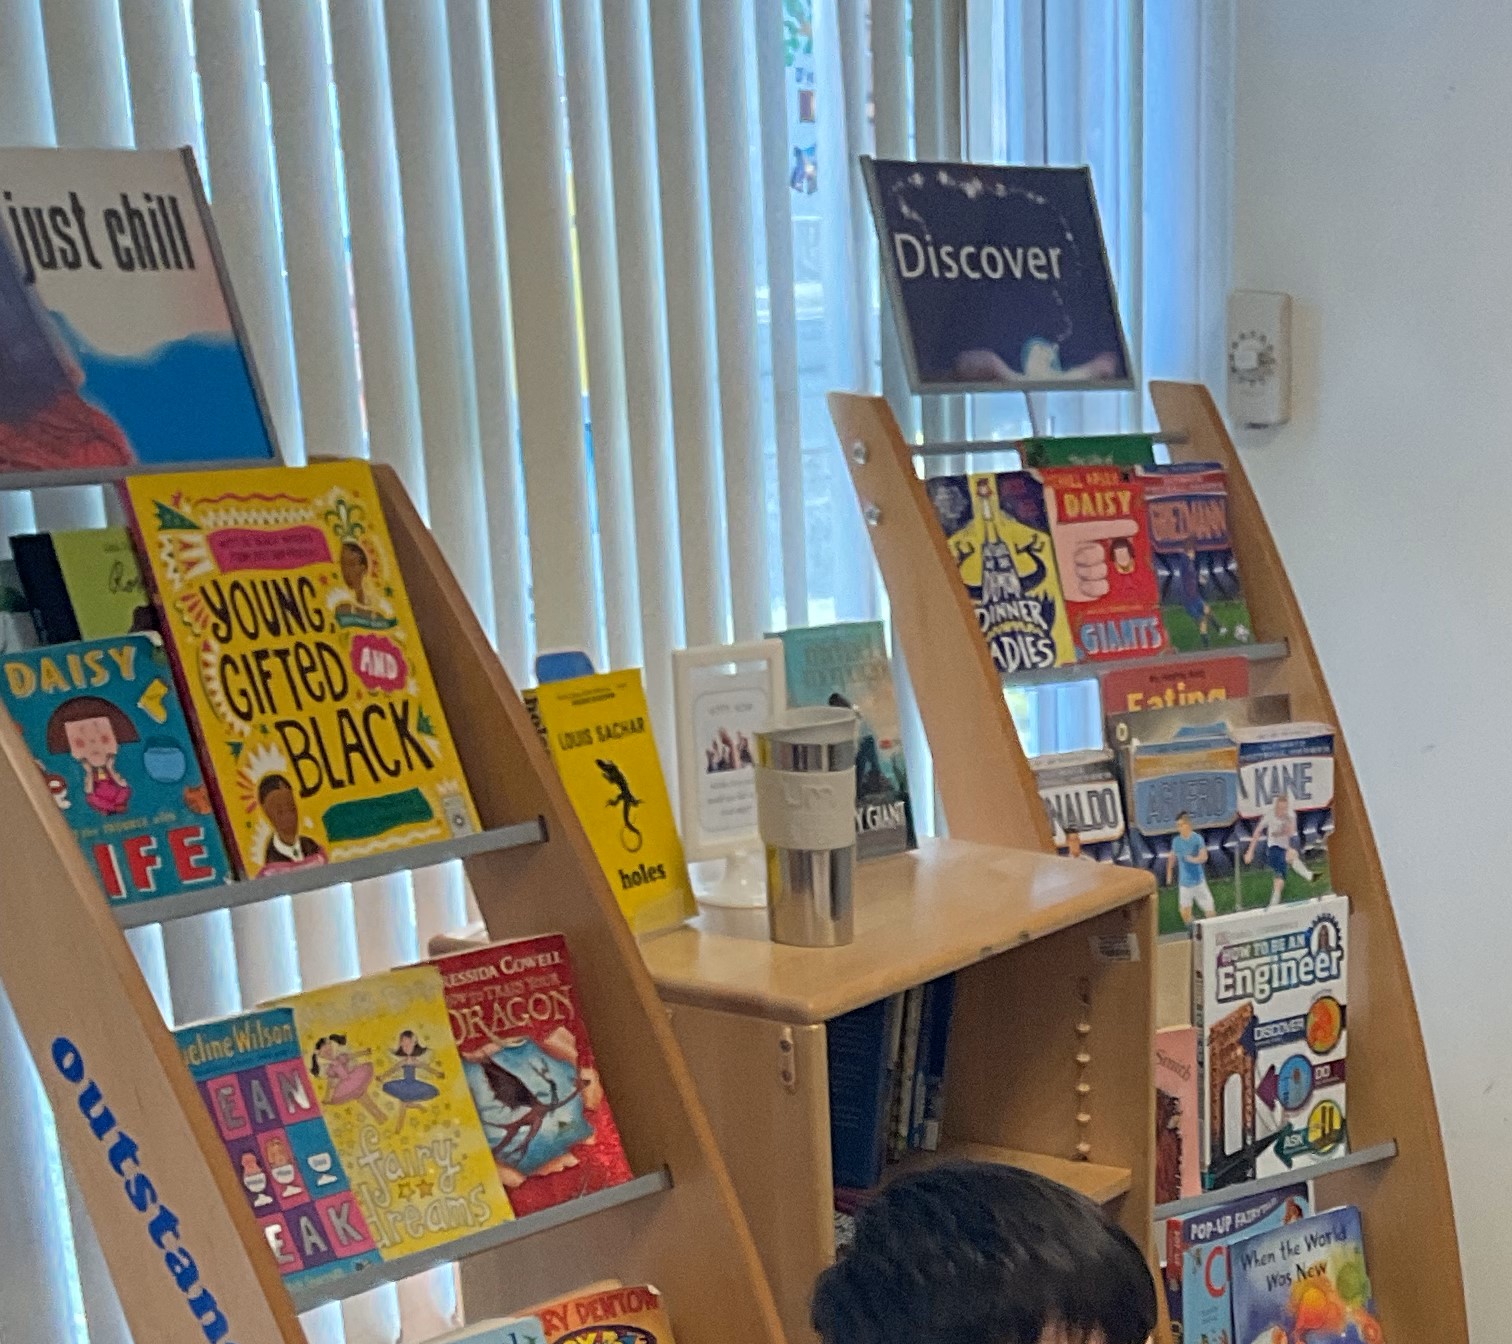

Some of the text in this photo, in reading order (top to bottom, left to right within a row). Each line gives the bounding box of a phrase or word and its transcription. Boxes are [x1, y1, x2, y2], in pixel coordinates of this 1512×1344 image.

[3, 191, 197, 284] just chill
[895, 231, 1063, 282] Discover
[1063, 490, 1131, 517] DAISY
[974, 601, 1048, 632] DINNER
[4, 645, 139, 699] DAISY
[359, 646, 400, 681] AND
[990, 635, 1055, 673] ADIES
[275, 699, 435, 799] BLACK
[1253, 760, 1314, 808] KANE
[1046, 786, 1120, 832] NALDO
[93, 825, 217, 900] IFE
[617, 863, 666, 890] holes
[444, 966, 499, 988] RESSIDA
[1217, 947, 1344, 1003] Engineer
[234, 1018, 293, 1053] Wilson
[449, 985, 576, 1047] DRAGON
[215, 1071, 311, 1131] EAN
[357, 1123, 461, 1204] fairy
[263, 1200, 365, 1265] EAK
[1190, 1215, 1233, 1241] POP-UP
[1240, 1225, 1348, 1272] When the World
[1266, 1258, 1330, 1293] Was New
